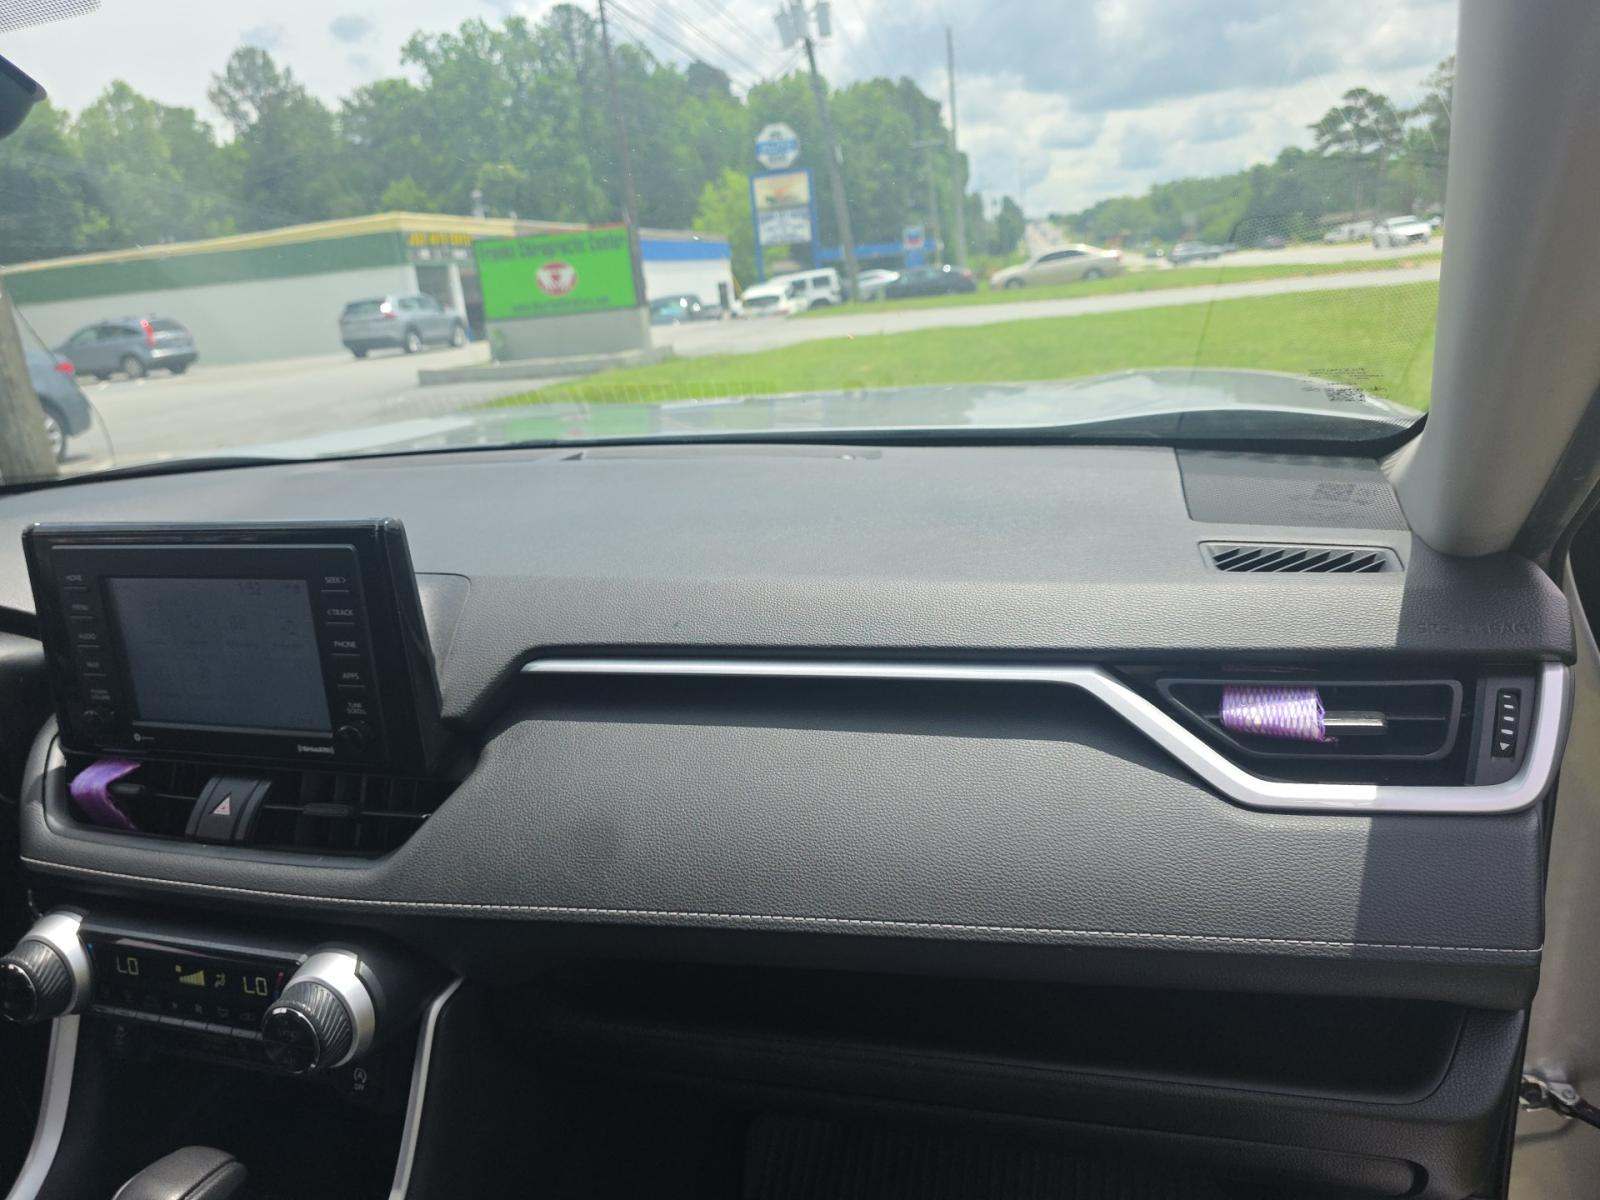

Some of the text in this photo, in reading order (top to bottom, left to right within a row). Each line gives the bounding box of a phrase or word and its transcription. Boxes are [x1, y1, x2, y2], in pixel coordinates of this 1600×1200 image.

[333, 641, 357, 649] PHONE
[342, 672, 360, 680] APPS
[116, 956, 140, 976] LO
[242, 976, 268, 997] LO
